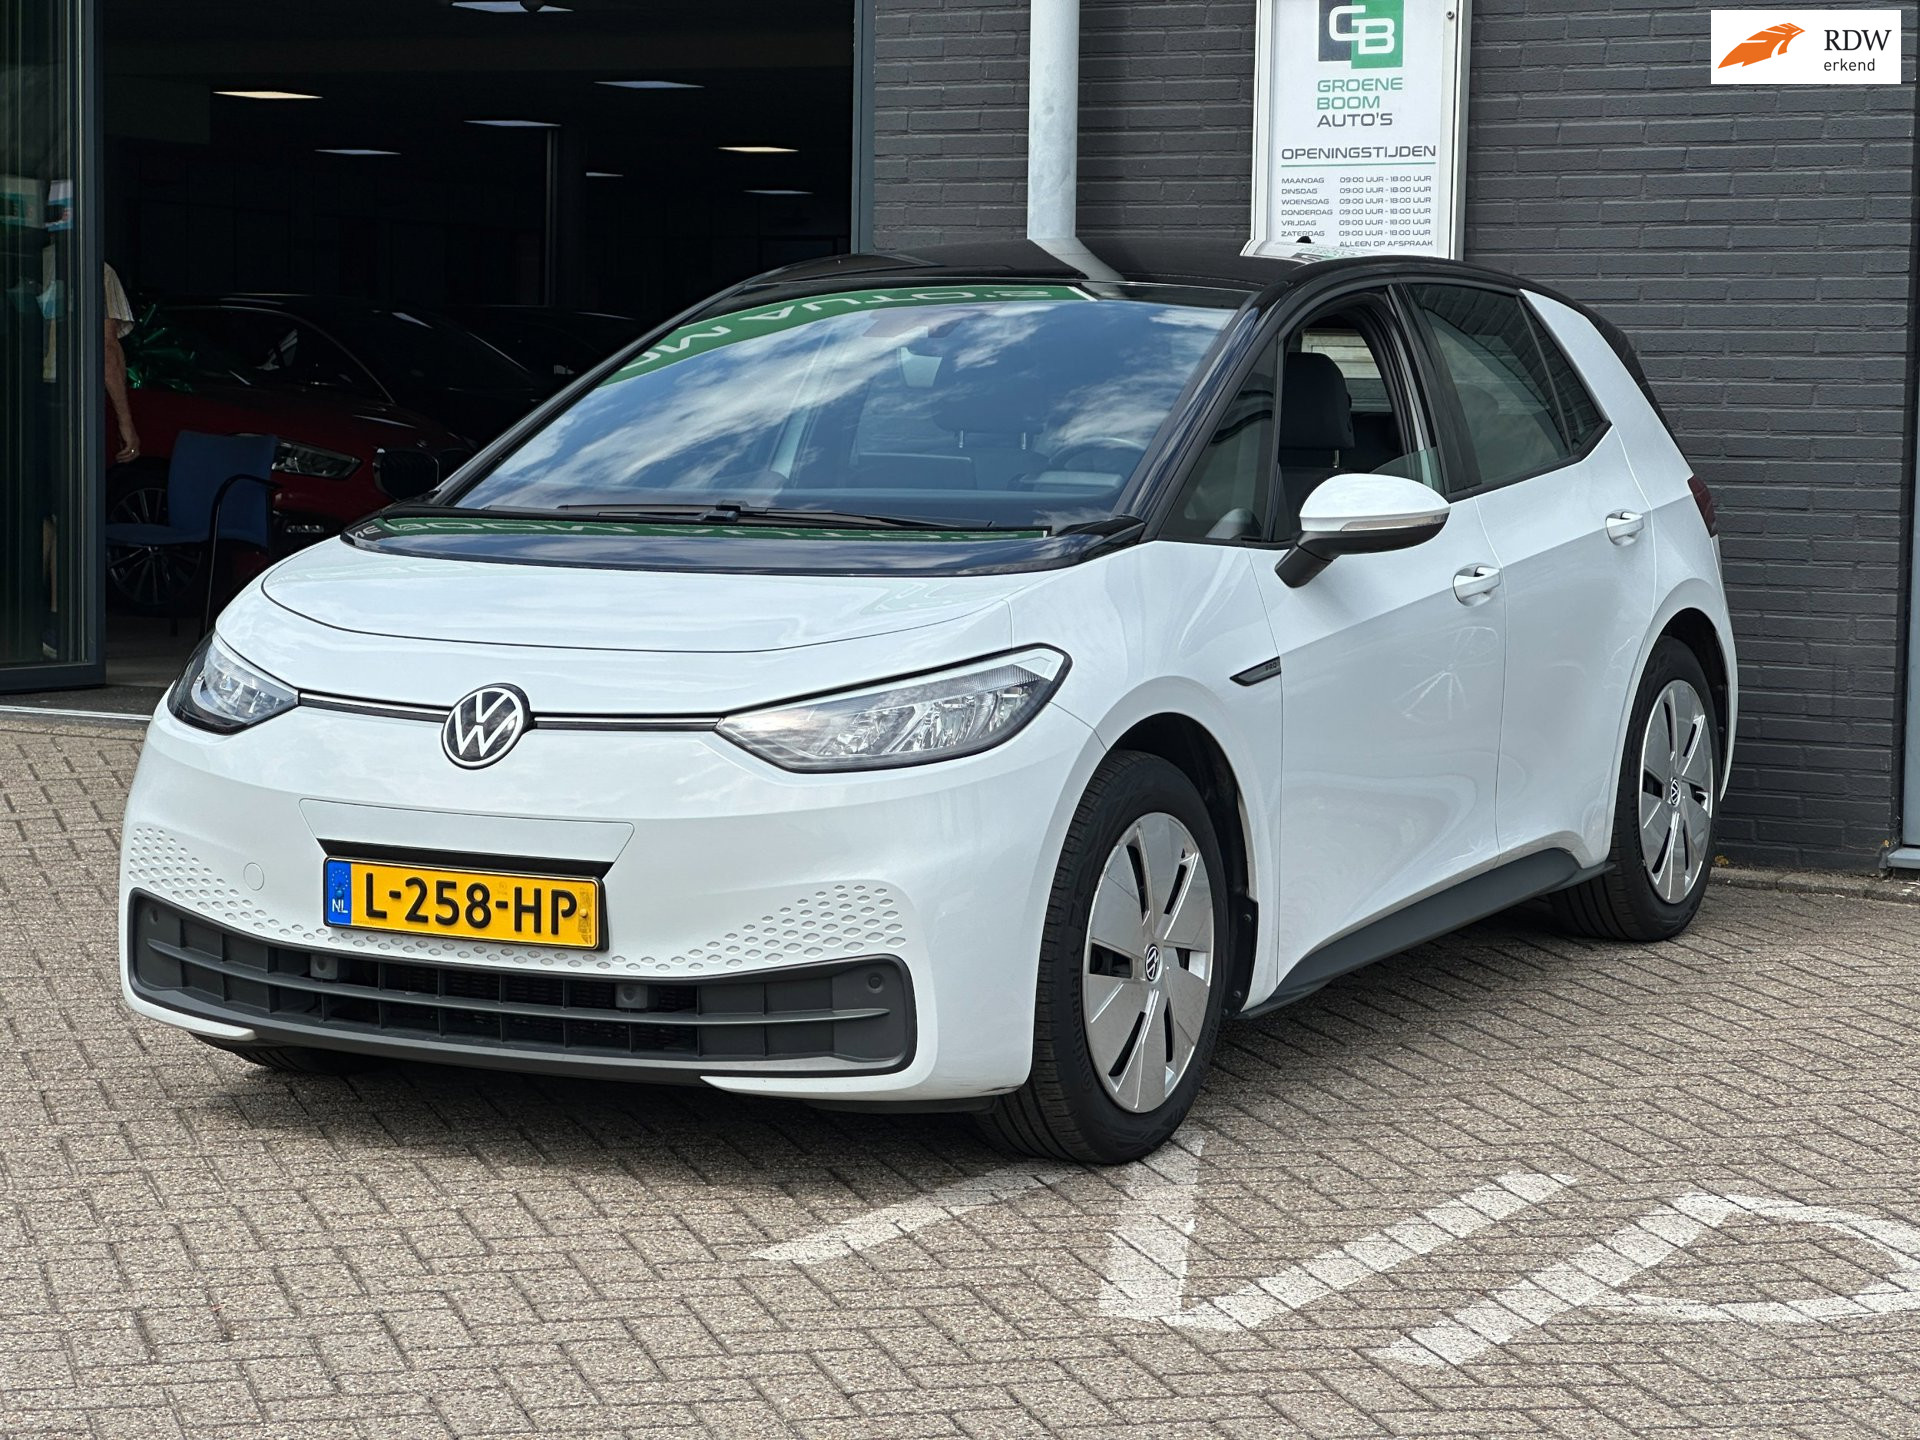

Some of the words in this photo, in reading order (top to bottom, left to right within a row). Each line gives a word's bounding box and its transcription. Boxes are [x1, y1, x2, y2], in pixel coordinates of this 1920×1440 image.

[1317, 77, 1403, 93] GROENE
[1316, 95, 1380, 110] BOOM
[1316, 112, 1393, 128] AUTO'S
[1281, 145, 1436, 160] OPENINGSTIJDEN
[331, 898, 349, 914] NL
[365, 872, 577, 936] L-258-HP
